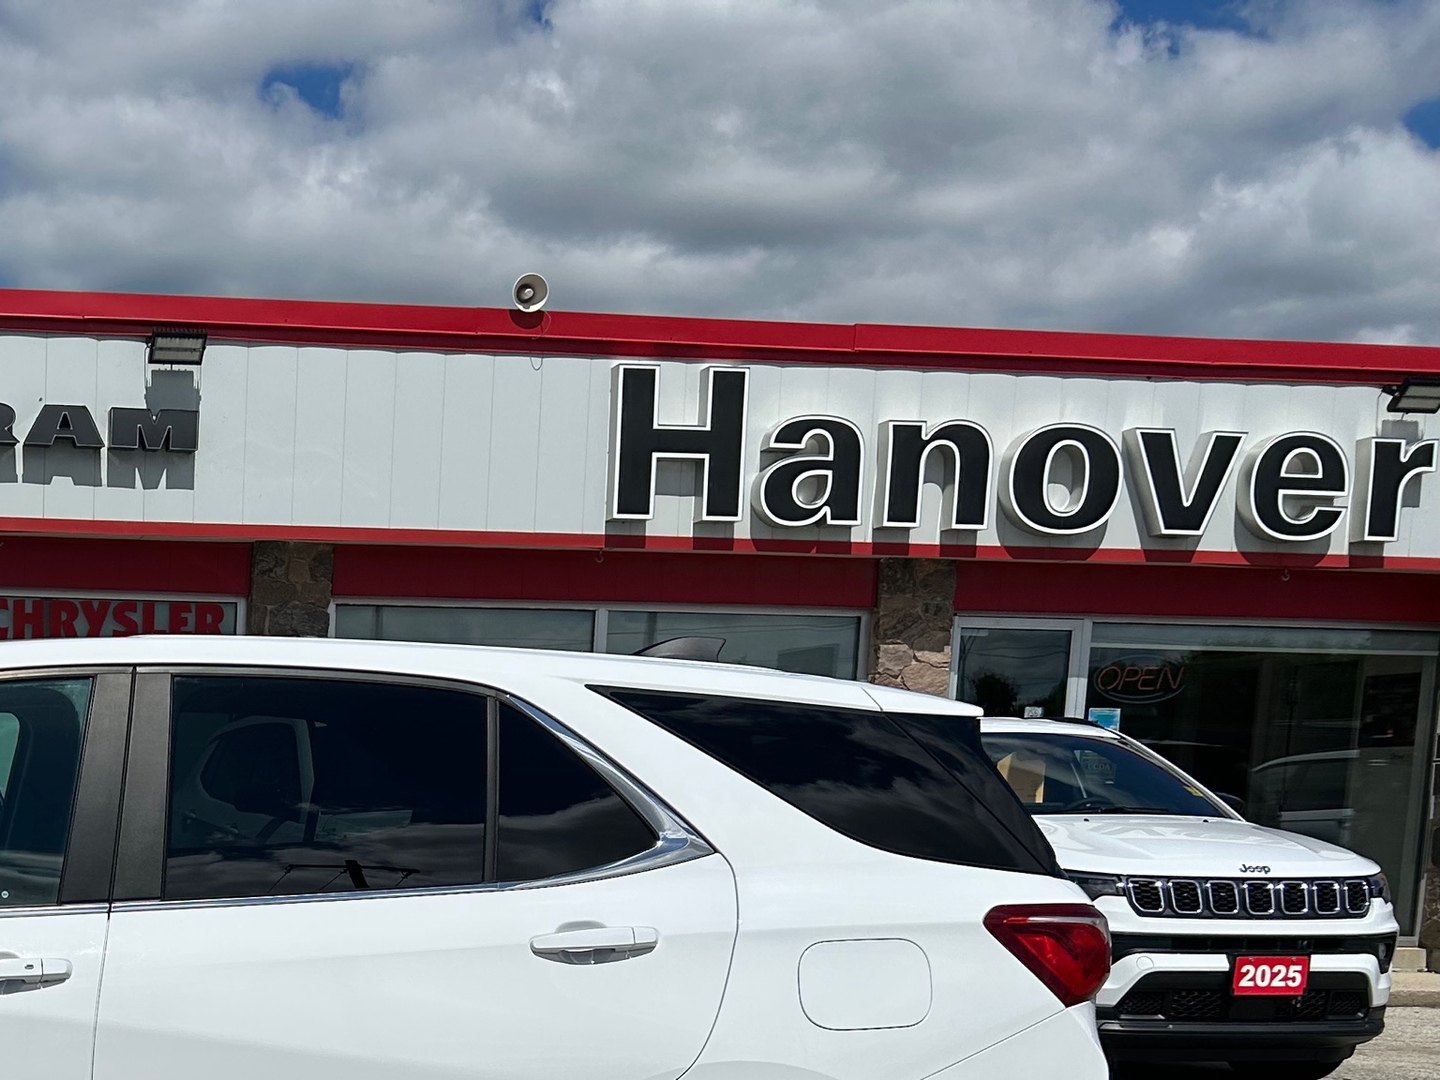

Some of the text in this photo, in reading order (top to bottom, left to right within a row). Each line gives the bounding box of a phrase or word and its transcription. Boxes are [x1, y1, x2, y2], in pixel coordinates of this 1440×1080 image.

[607, 363, 1438, 542] Hanover
[1097, 665, 1185, 691] OPEN
[1239, 863, 1272, 875] Jeep
[1237, 964, 1303, 988] 2025
